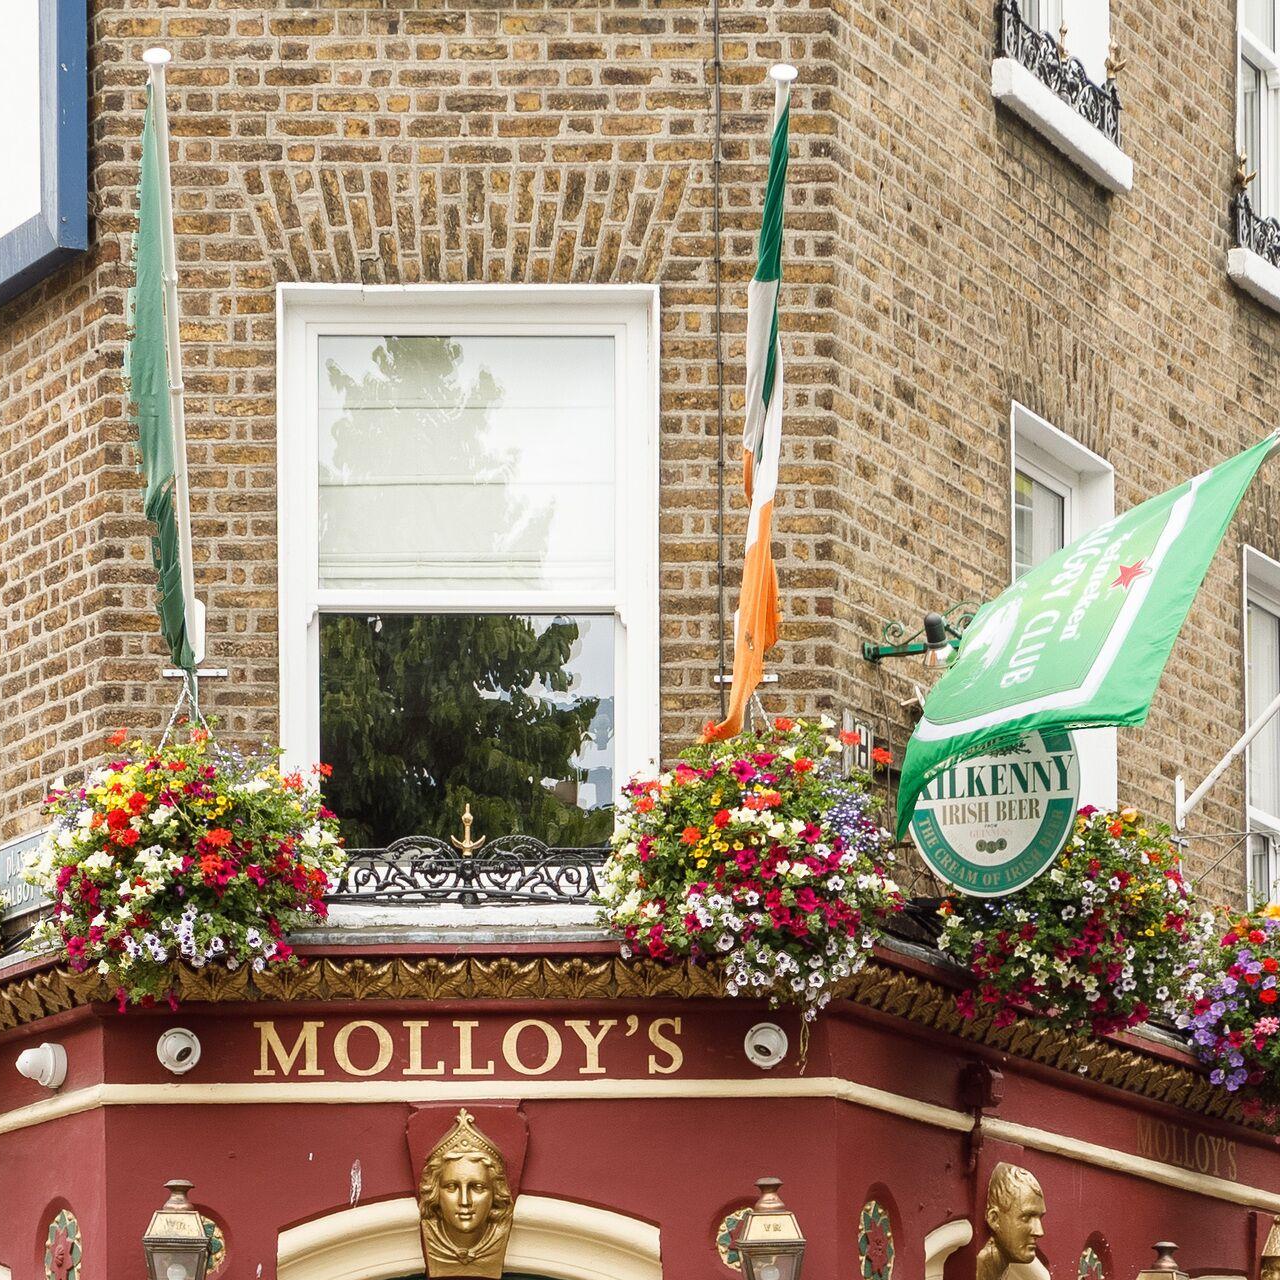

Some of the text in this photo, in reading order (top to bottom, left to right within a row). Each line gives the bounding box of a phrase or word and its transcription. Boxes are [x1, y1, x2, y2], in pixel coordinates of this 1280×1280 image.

[1000, 609, 1060, 688] CLUB
[942, 797, 1041, 826] IRISH BEER
[918, 817, 937, 849] THE
[934, 848, 978, 886] CREAM
[982, 873, 1001, 887] OF
[1006, 850, 1043, 882] IRISH
[253, 1015, 684, 1077] MOLLOY'S
[1136, 1117, 1237, 1181] MOLLOY'S
